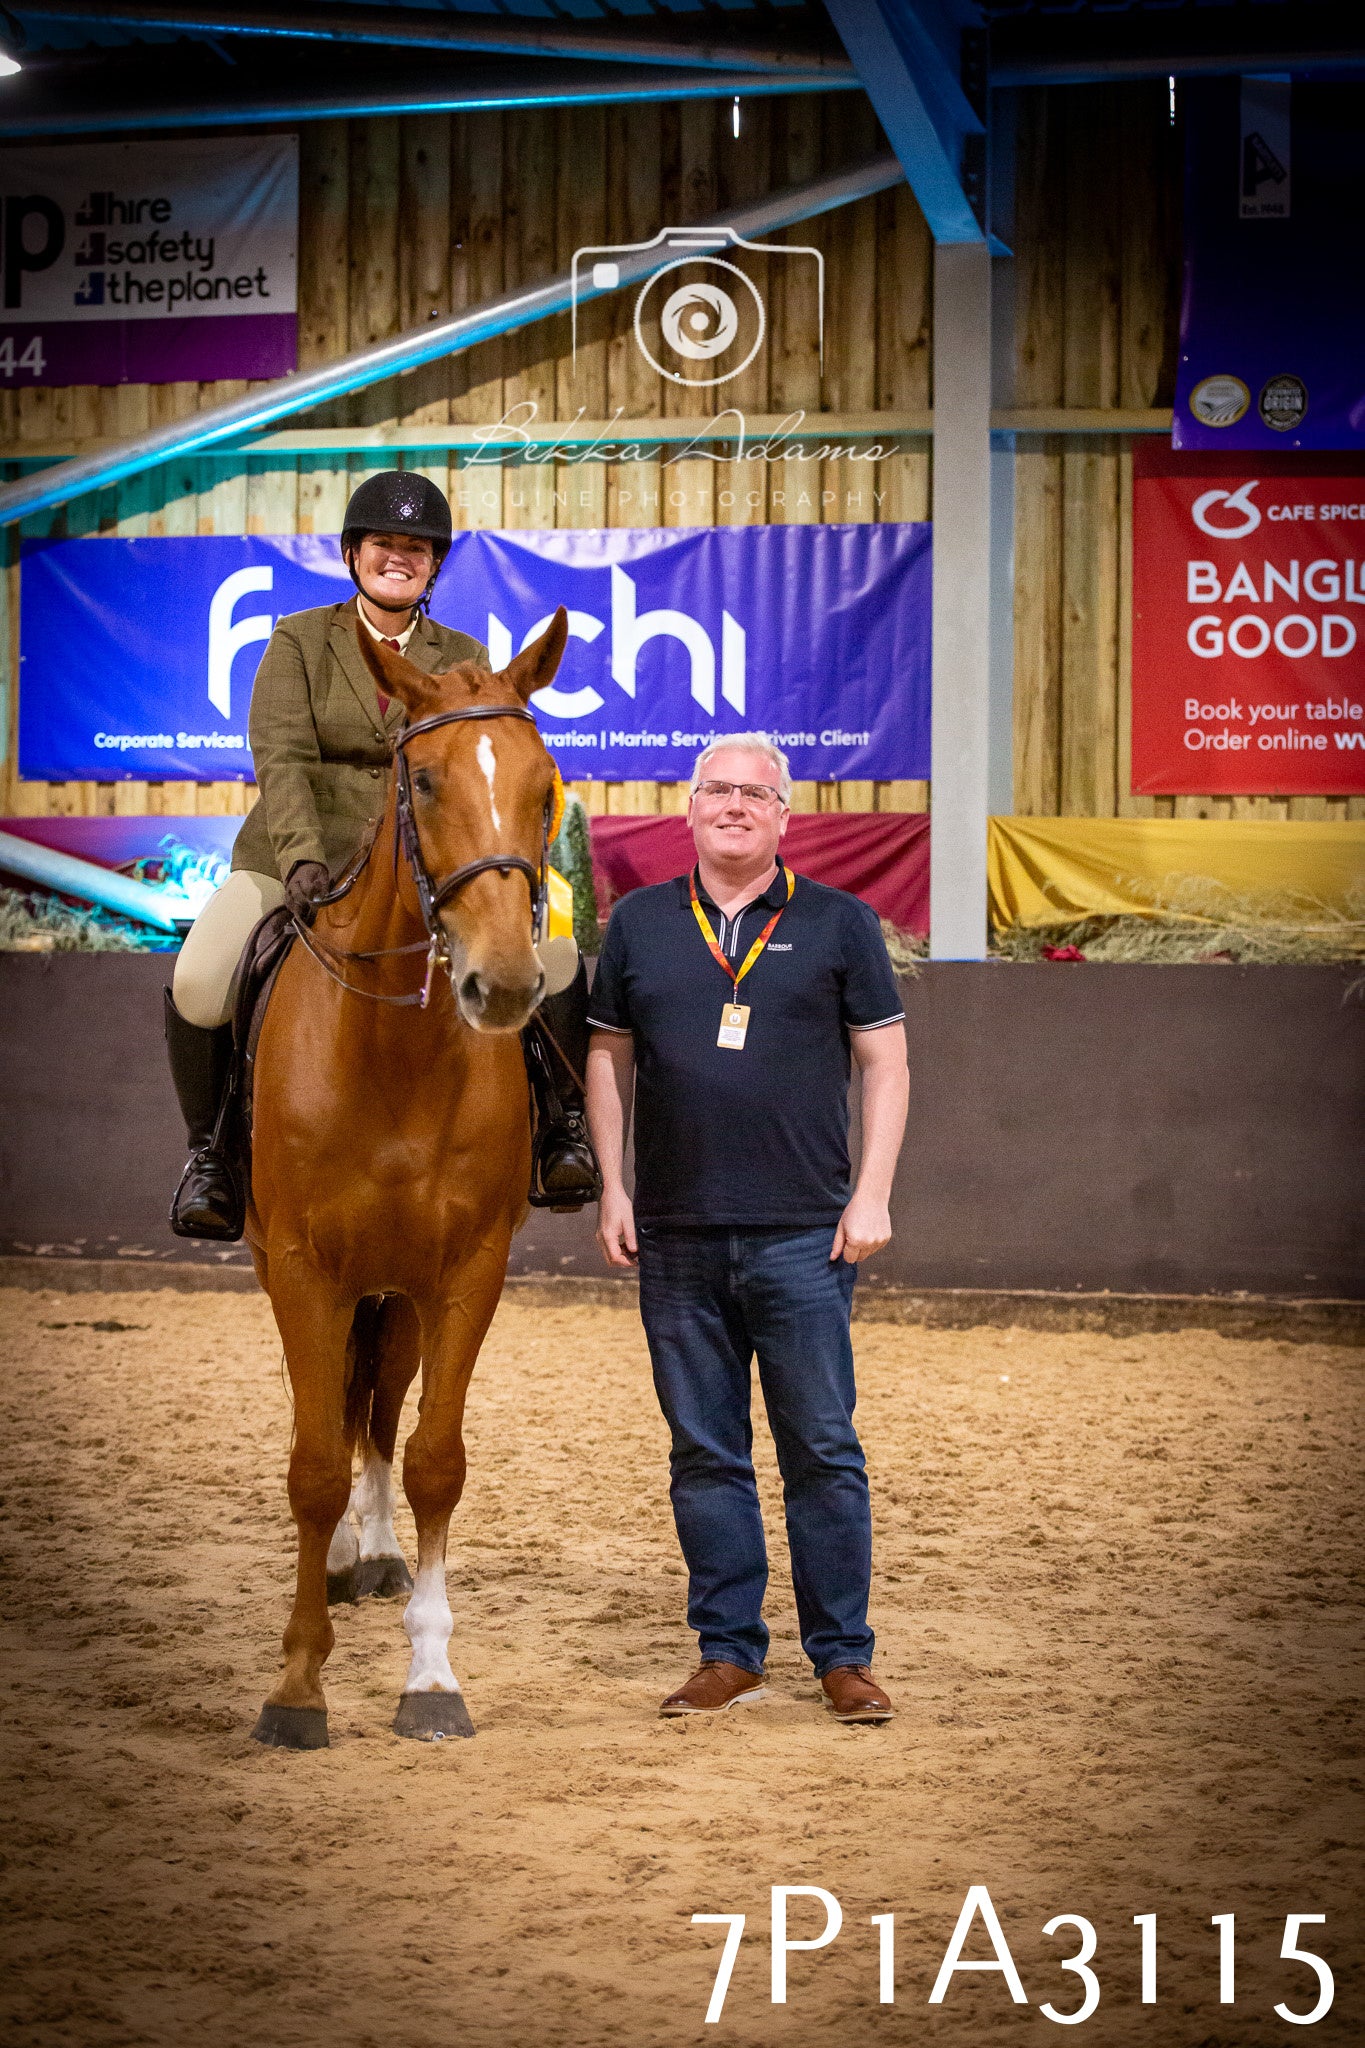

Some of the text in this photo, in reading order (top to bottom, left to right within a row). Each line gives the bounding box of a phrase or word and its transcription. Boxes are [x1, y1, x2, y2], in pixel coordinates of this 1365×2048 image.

[1267, 505, 1315, 521] CAFE
[1187, 614, 1357, 659] GOOD
[1184, 697, 1363, 725] Book your table
[94, 731, 245, 752] Corporate Services
[610, 729, 668, 747] Marine
[820, 729, 871, 747] Client
[1184, 727, 1252, 751] Order
[1257, 727, 1327, 751] online
